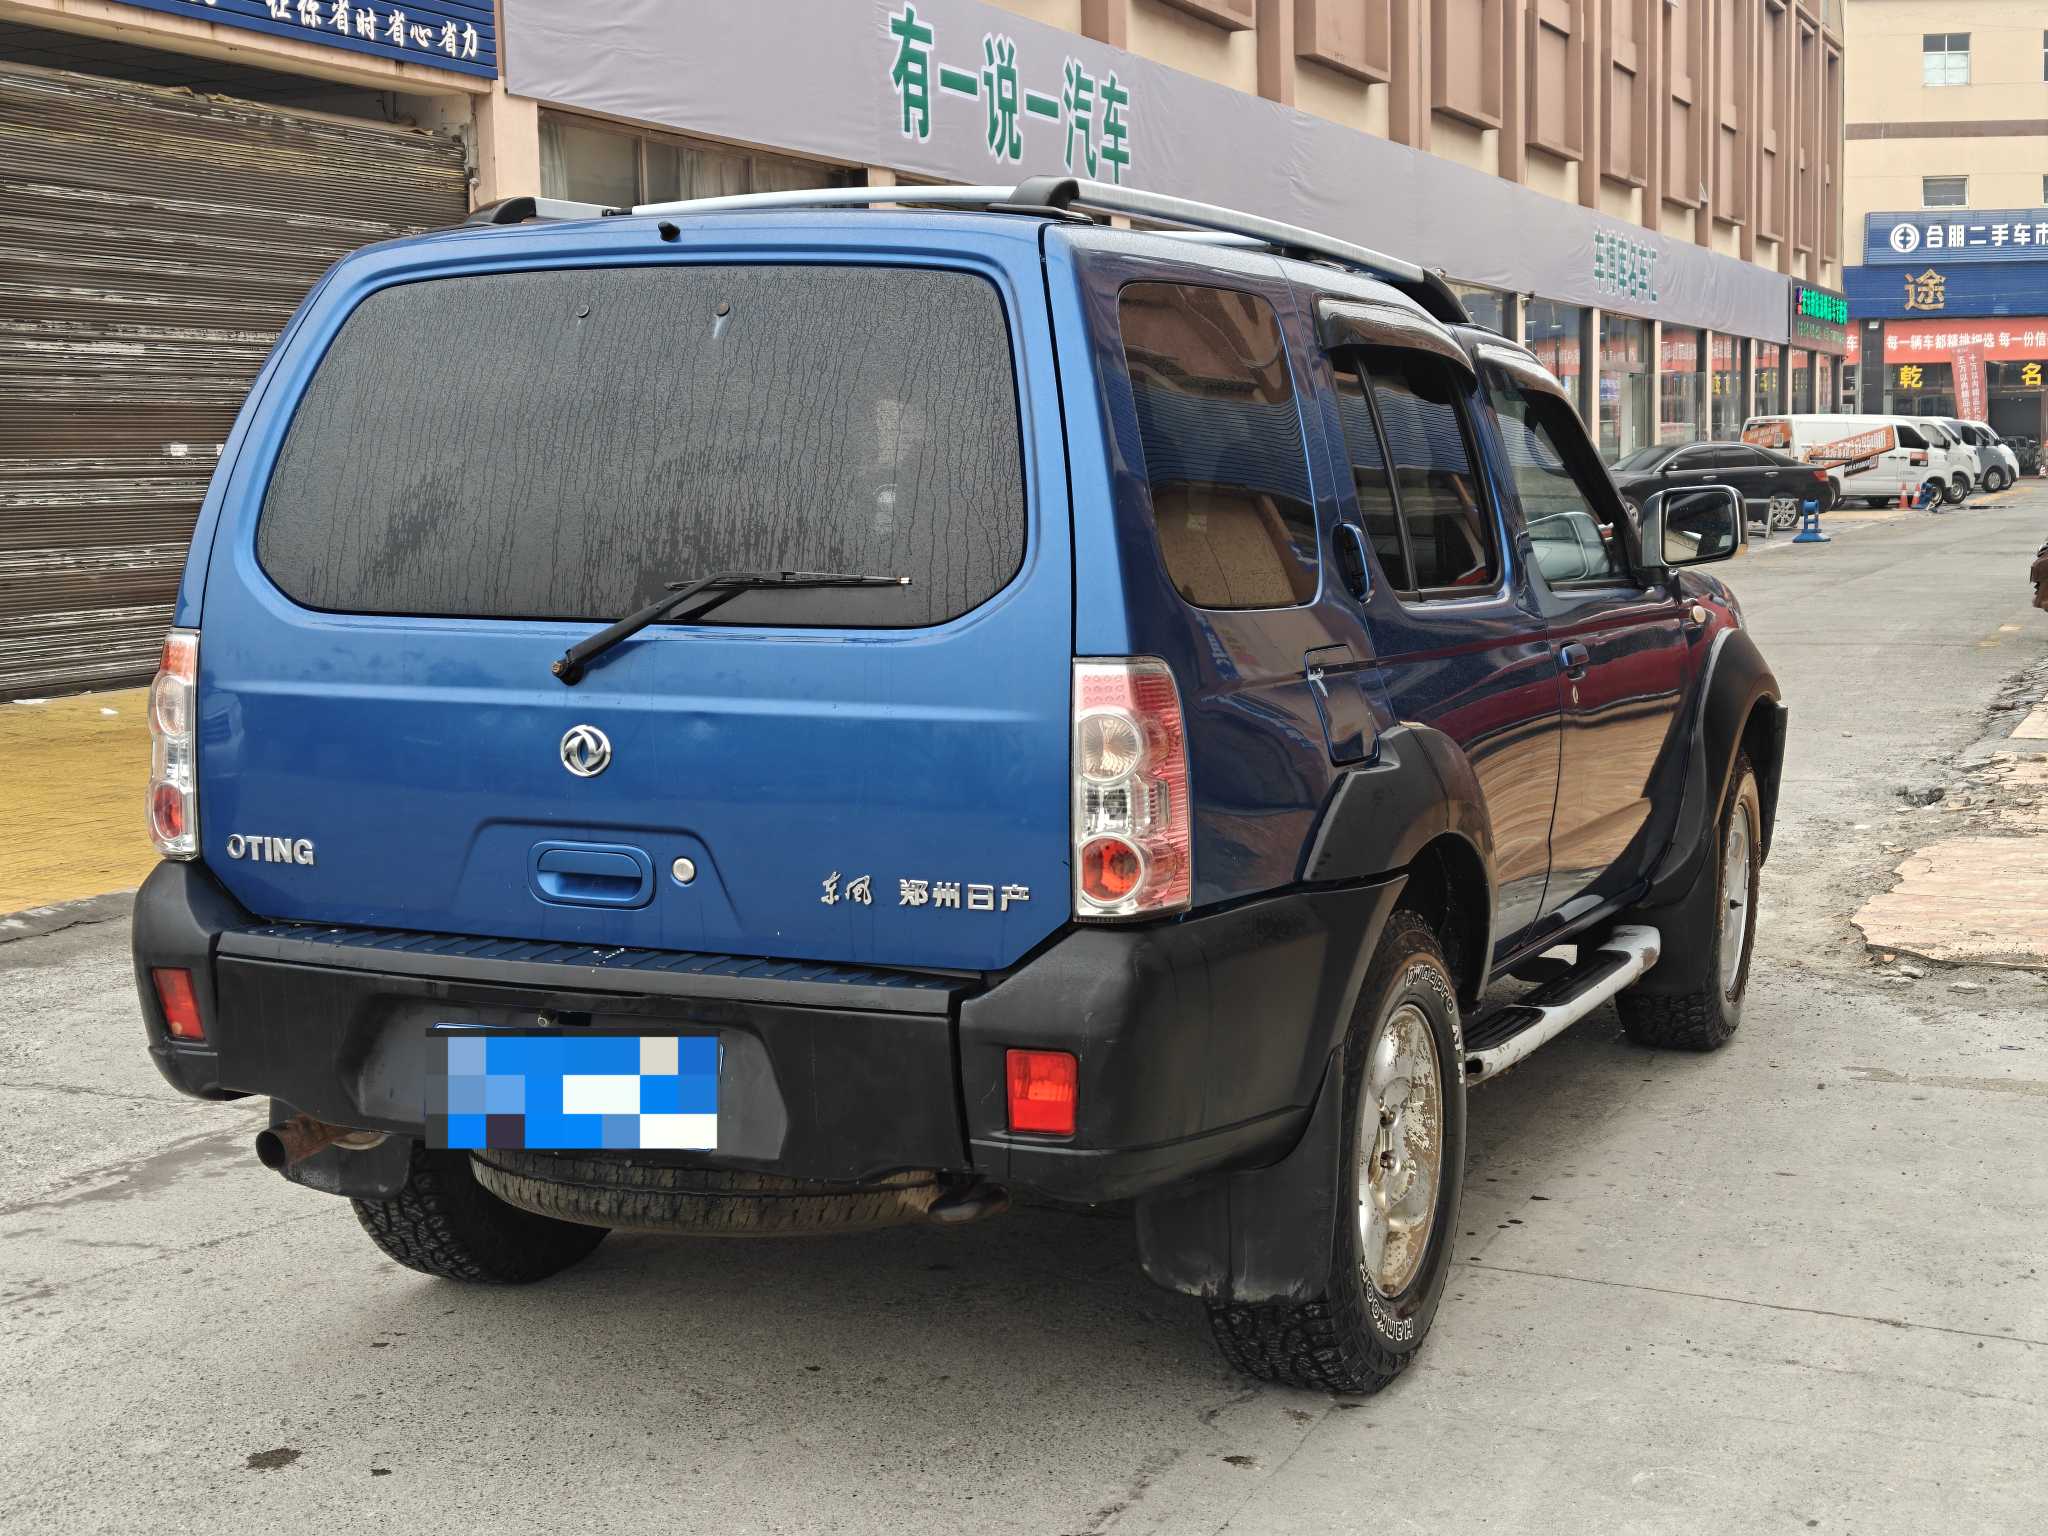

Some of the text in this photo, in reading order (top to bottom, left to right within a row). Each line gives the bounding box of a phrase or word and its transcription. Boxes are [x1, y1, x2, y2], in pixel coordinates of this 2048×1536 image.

[888, 1, 1131, 185] 有一说一汽车
[1903, 268, 1947, 311] 途
[2021, 362, 2042, 386] 名
[226, 833, 315, 866] OTING
[899, 878, 1030, 912] 郑州日产
